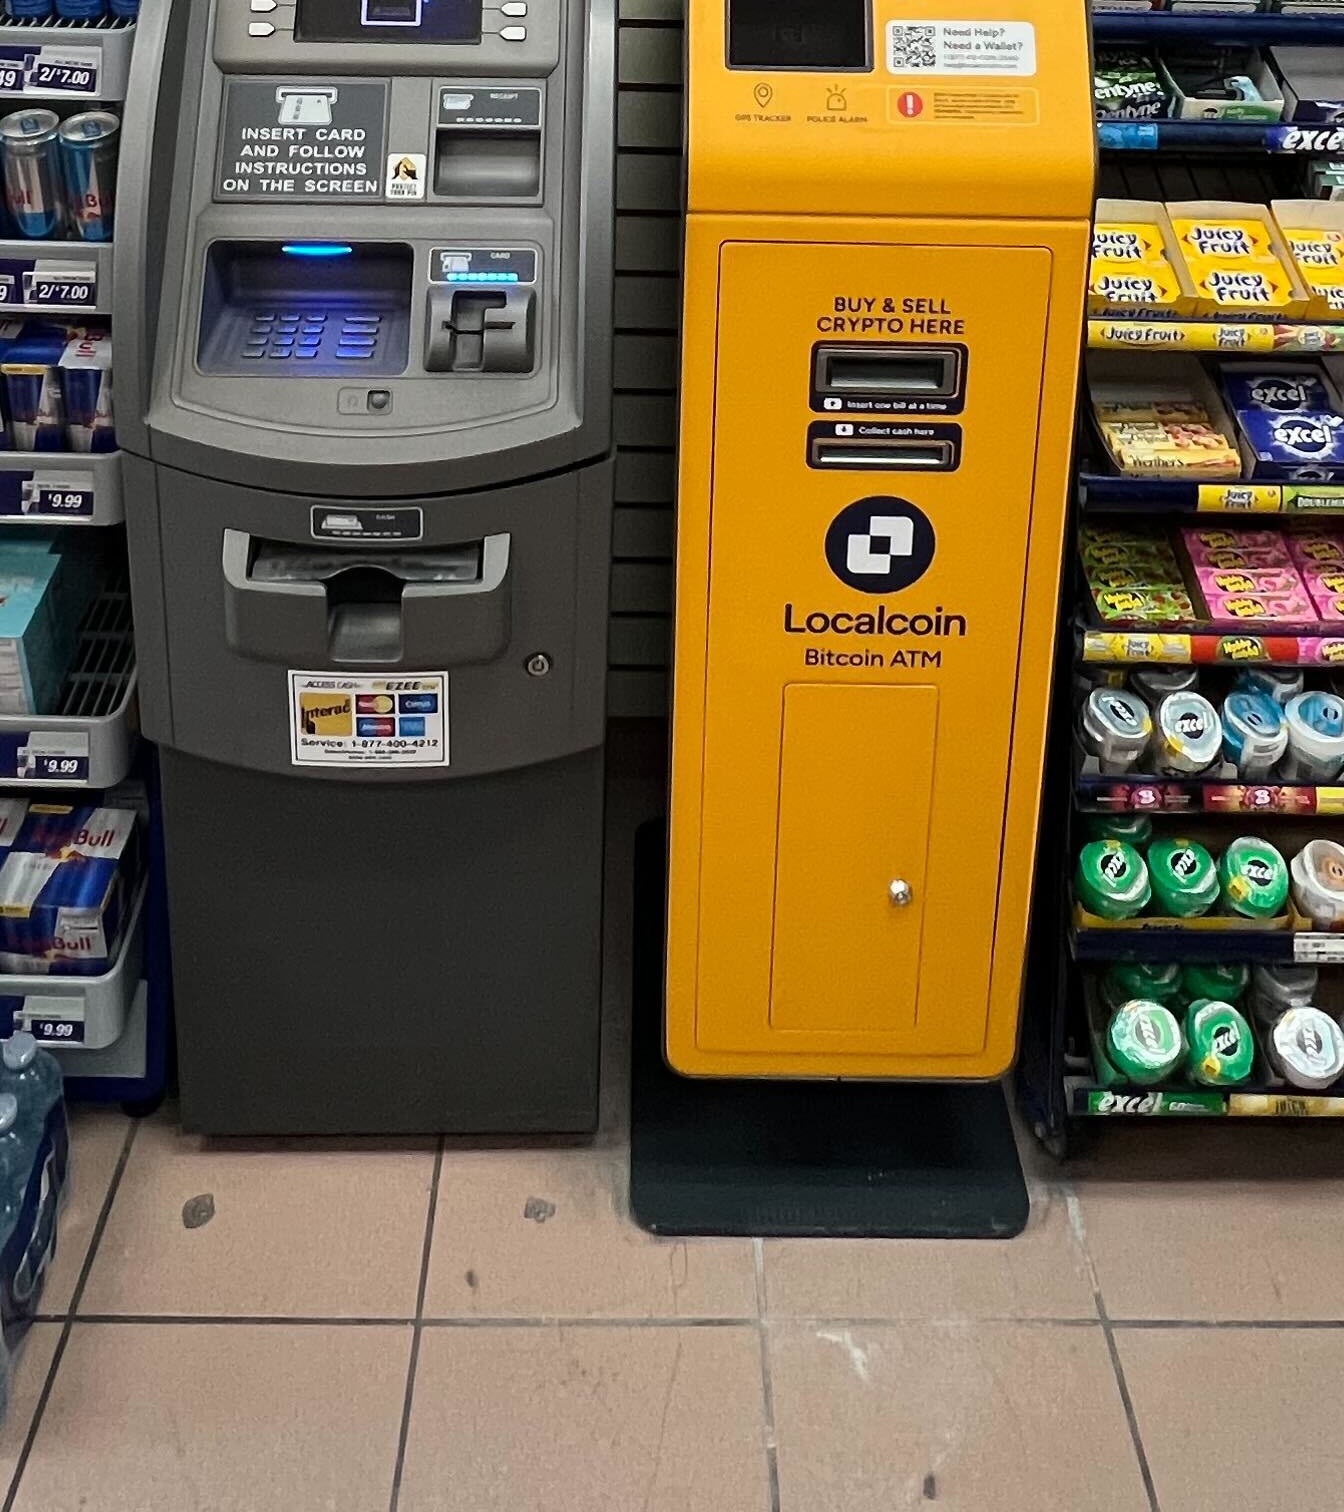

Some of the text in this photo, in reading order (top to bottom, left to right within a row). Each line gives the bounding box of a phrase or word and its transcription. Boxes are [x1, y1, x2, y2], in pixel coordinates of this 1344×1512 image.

[943, 27, 1006, 38] Need Help?
[943, 40, 972, 50] Need
[984, 41, 1023, 51] Wallet?
[38, 67, 89, 85] 2/$7.00
[242, 128, 366, 141] INSERT CARD
[241, 145, 365, 158] AND FOLLOW
[235, 162, 367, 175] INSTRUCTIONS
[223, 179, 378, 193] ON THE SCREEN
[1190, 227, 1244, 245] Juicy
[1215, 286, 1270, 303] Fruit
[834, 296, 951, 315] BUY & SELL
[817, 317, 965, 335] CRYPTO HERE
[1105, 326, 1180, 342] Juicy Fruit
[1252, 386, 1306, 403] excel
[859, 425, 891, 435] Collect
[1274, 426, 1333, 446] excel
[48, 493, 82, 509] $9.99
[784, 603, 966, 637] Localcoin
[804, 648, 942, 668] Bitcoin ATM
[386, 681, 422, 691] EZEE
[301, 699, 351, 726] Interac
[351, 739, 438, 748] 1-877-400-4212
[44, 759, 78, 773] $9.99
[73, 830, 114, 847] Bull
[39, 1024, 73, 1037] $9.99
[1099, 1092, 1162, 1113] excel
